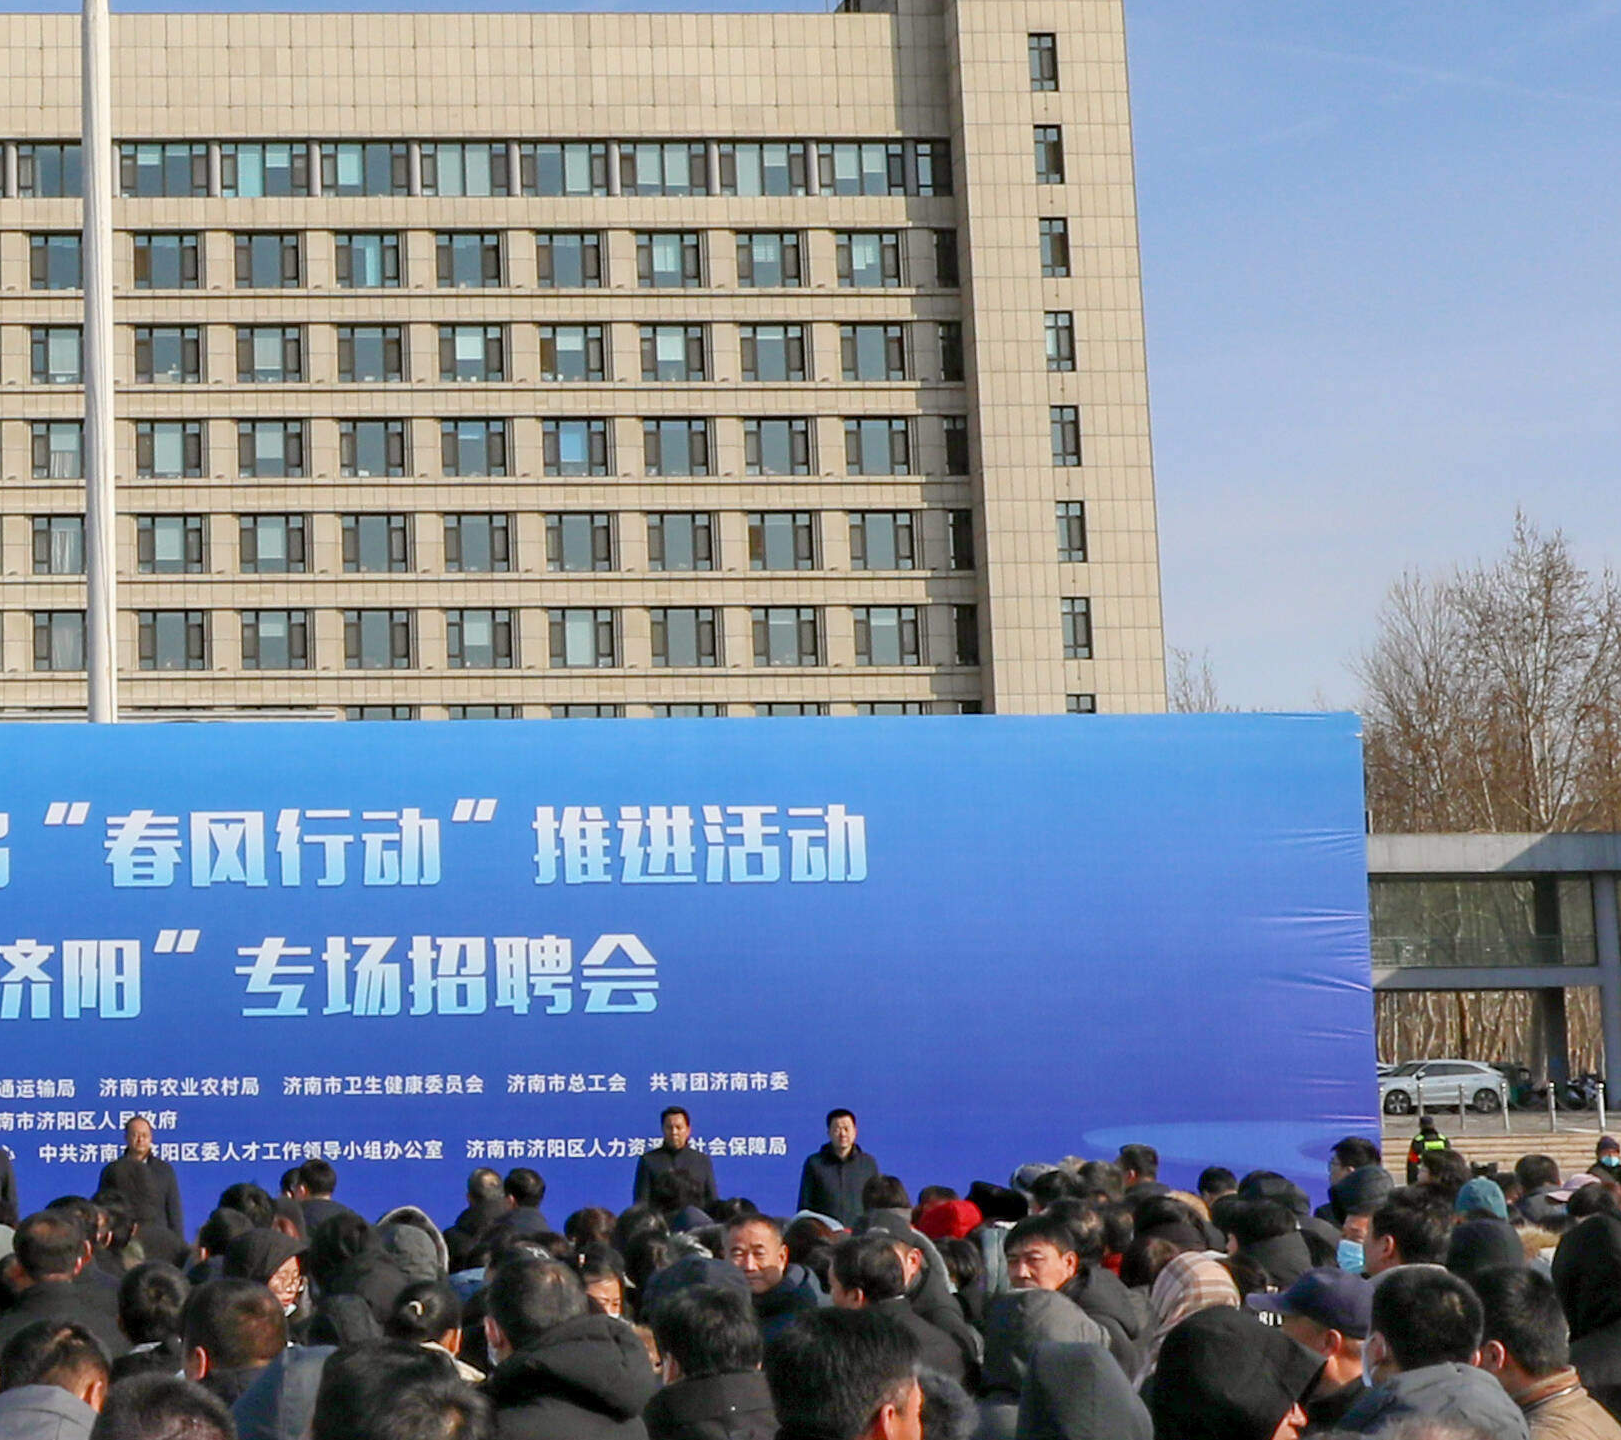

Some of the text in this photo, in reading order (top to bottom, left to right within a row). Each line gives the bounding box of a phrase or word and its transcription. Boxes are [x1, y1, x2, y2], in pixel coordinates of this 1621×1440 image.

[99, 1076, 260, 1097] 济南市农业农村局
[282, 1074, 484, 1096] 济南市卫生健康委员会
[506, 1073, 627, 1094] 济南市总工会
[649, 1070, 790, 1092] 共青团济南市委
[39, 1139, 444, 1163] 中共济南阳区委人才工作领导小组办公室
[465, 1136, 788, 1159] 济南市济阳区人力资社会保障局
